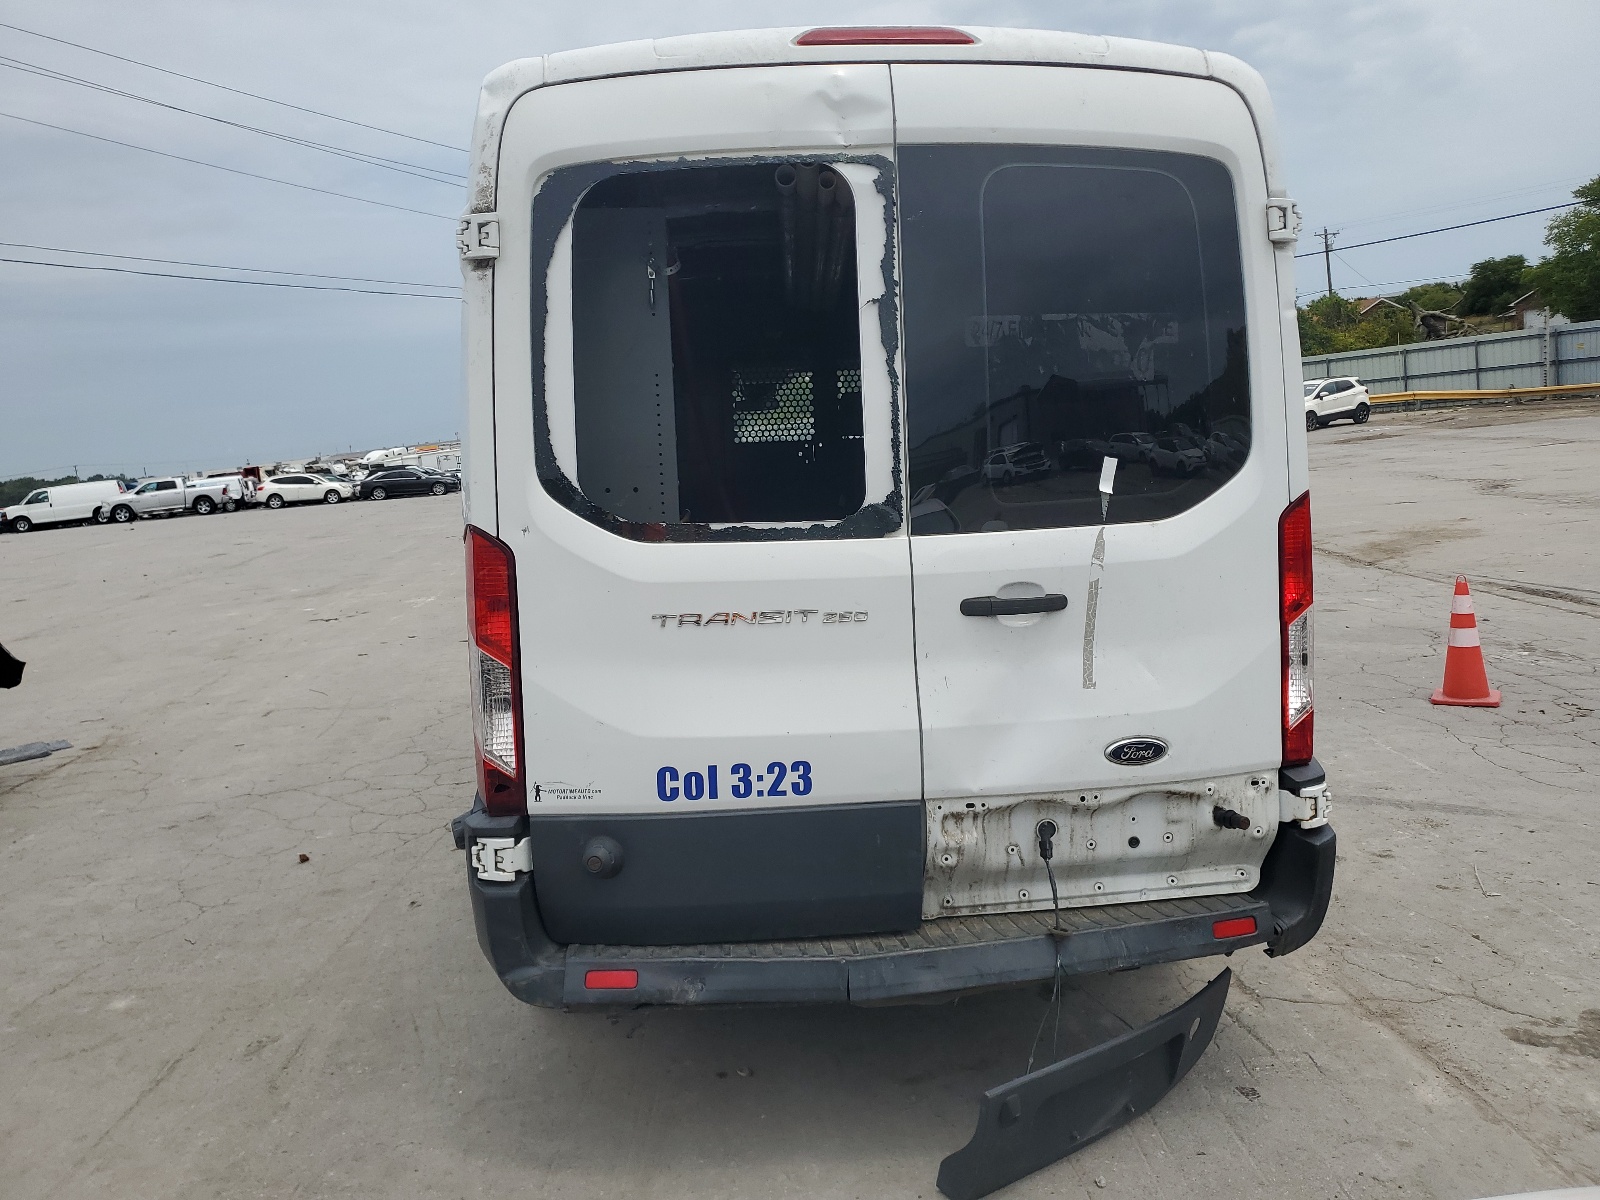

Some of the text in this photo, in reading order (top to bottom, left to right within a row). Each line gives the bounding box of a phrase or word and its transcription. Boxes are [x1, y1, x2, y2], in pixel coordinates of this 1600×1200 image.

[651, 608, 869, 628] TRANSIT 250
[656, 760, 813, 802] Col 3:23
